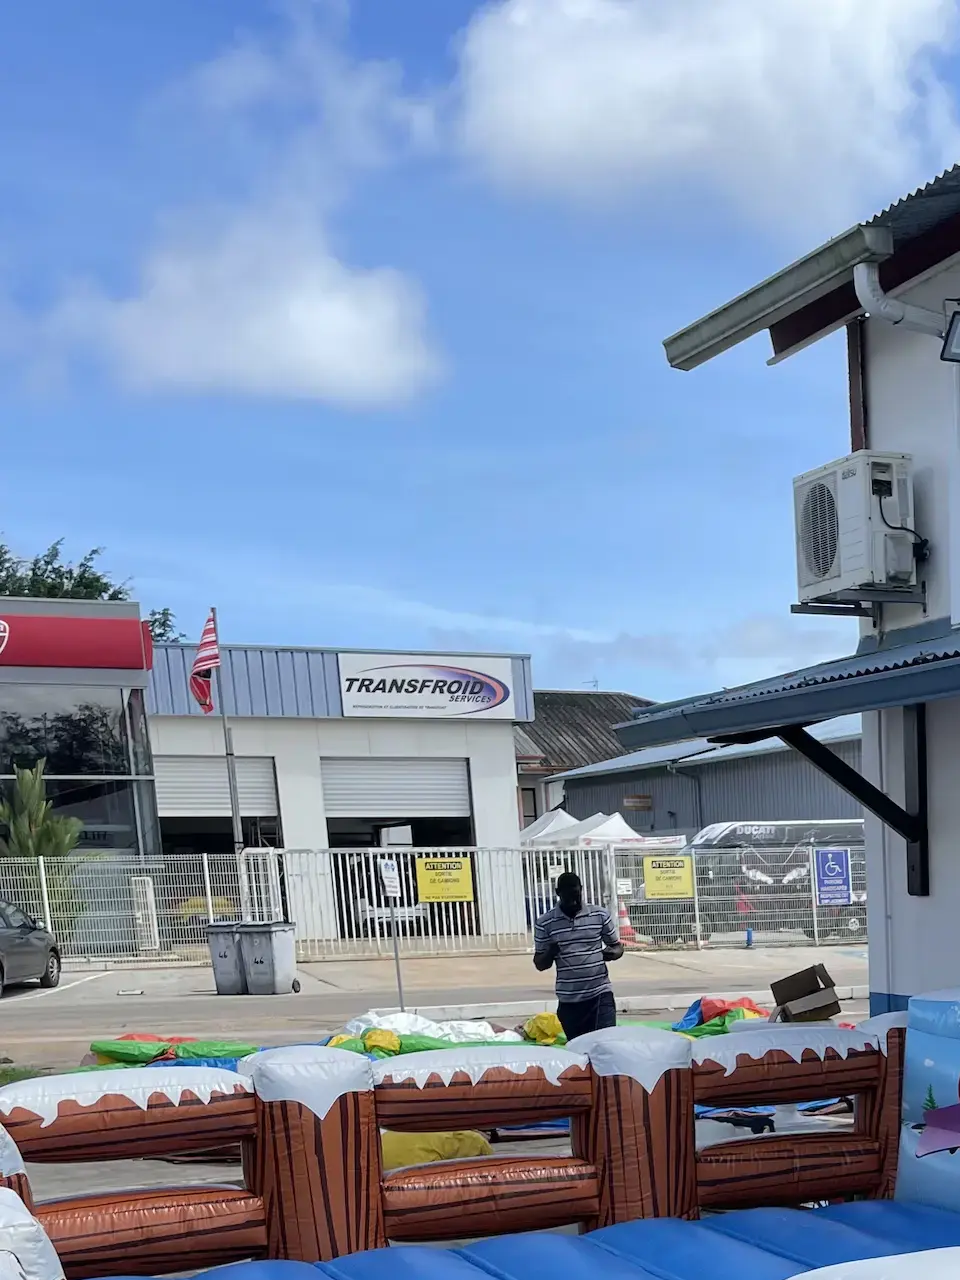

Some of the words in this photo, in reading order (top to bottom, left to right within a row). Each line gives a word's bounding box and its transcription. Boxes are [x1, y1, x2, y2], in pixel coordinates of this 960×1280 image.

[345, 678, 485, 695] TRANSFROID
[449, 695, 492, 704] SERVICES
[736, 826, 776, 835] DUCATI
[425, 862, 462, 870] ATTENTION
[652, 861, 684, 869] ATTENTION
[219, 951, 228, 959] 46
[254, 957, 264, 965] 46
